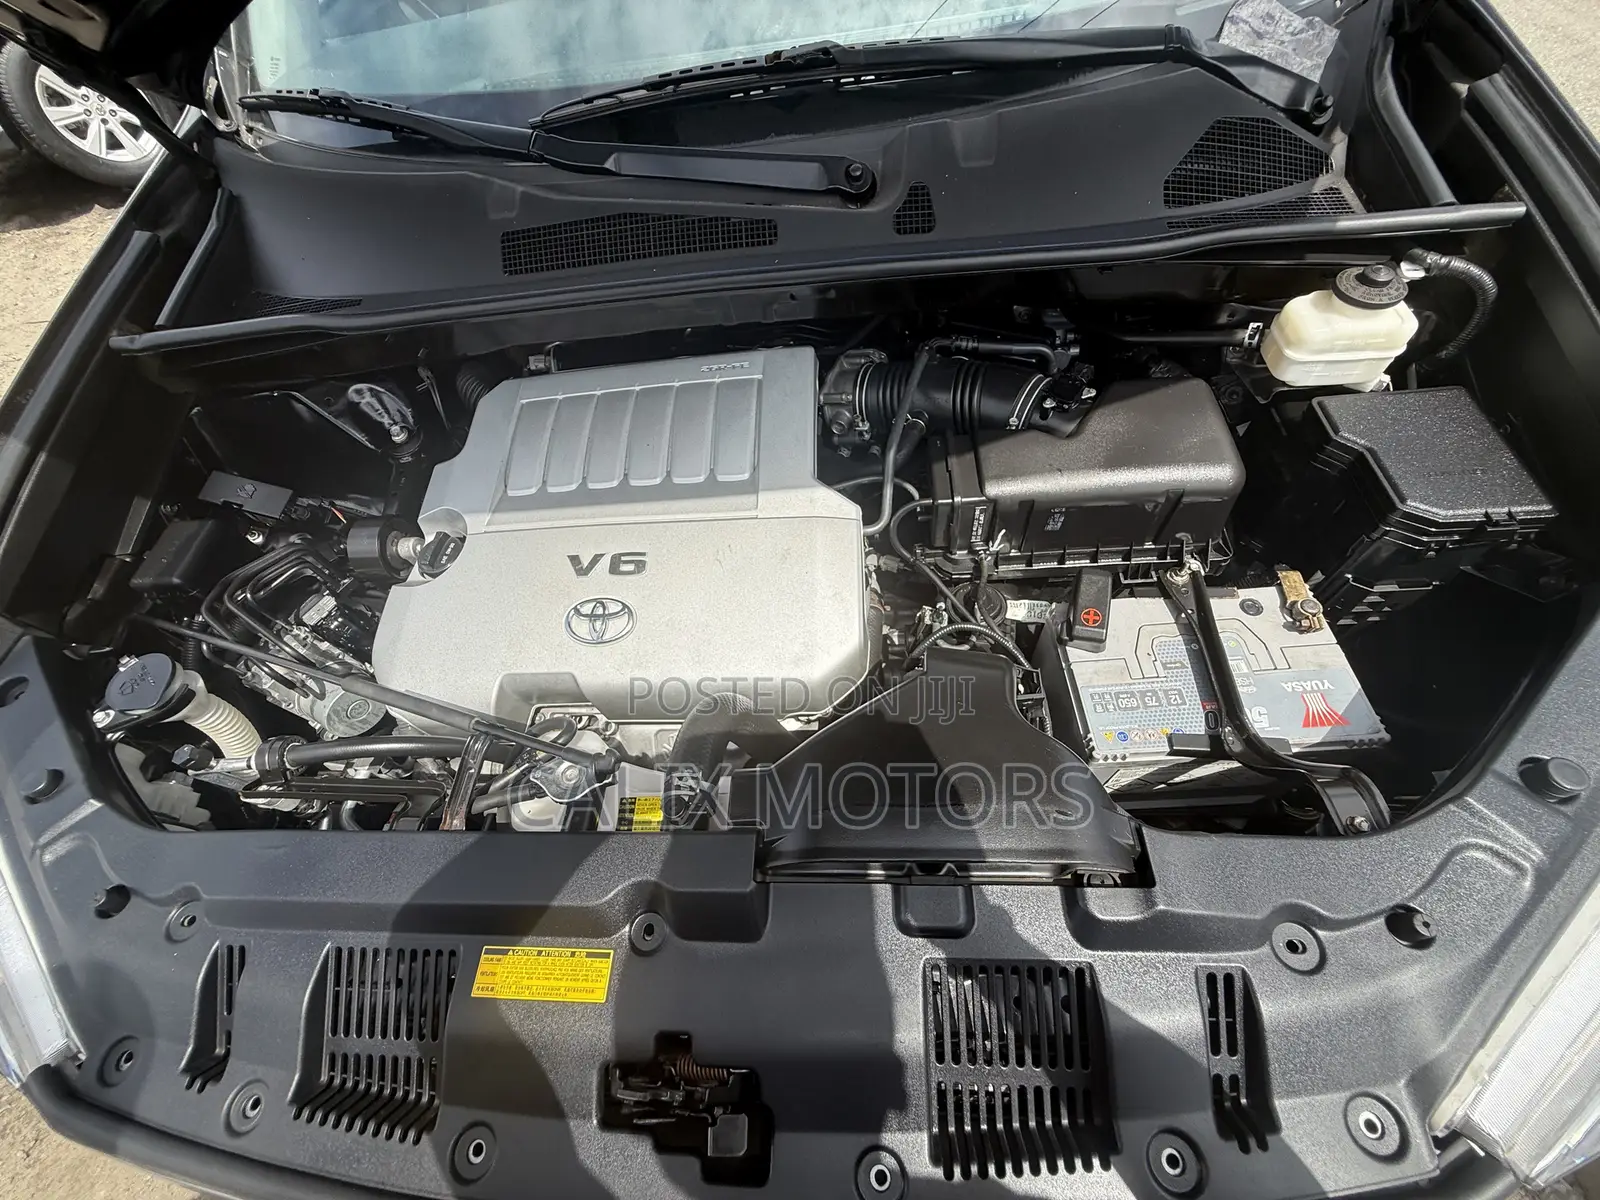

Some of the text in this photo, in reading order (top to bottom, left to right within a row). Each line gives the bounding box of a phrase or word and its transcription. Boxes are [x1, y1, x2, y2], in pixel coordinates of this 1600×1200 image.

[566, 552, 647, 577] V6
[1280, 679, 1336, 692] YUASA
[1118, 697, 1138, 708] 650
[1144, 696, 1159, 706] 75
[1168, 694, 1183, 704] 12
